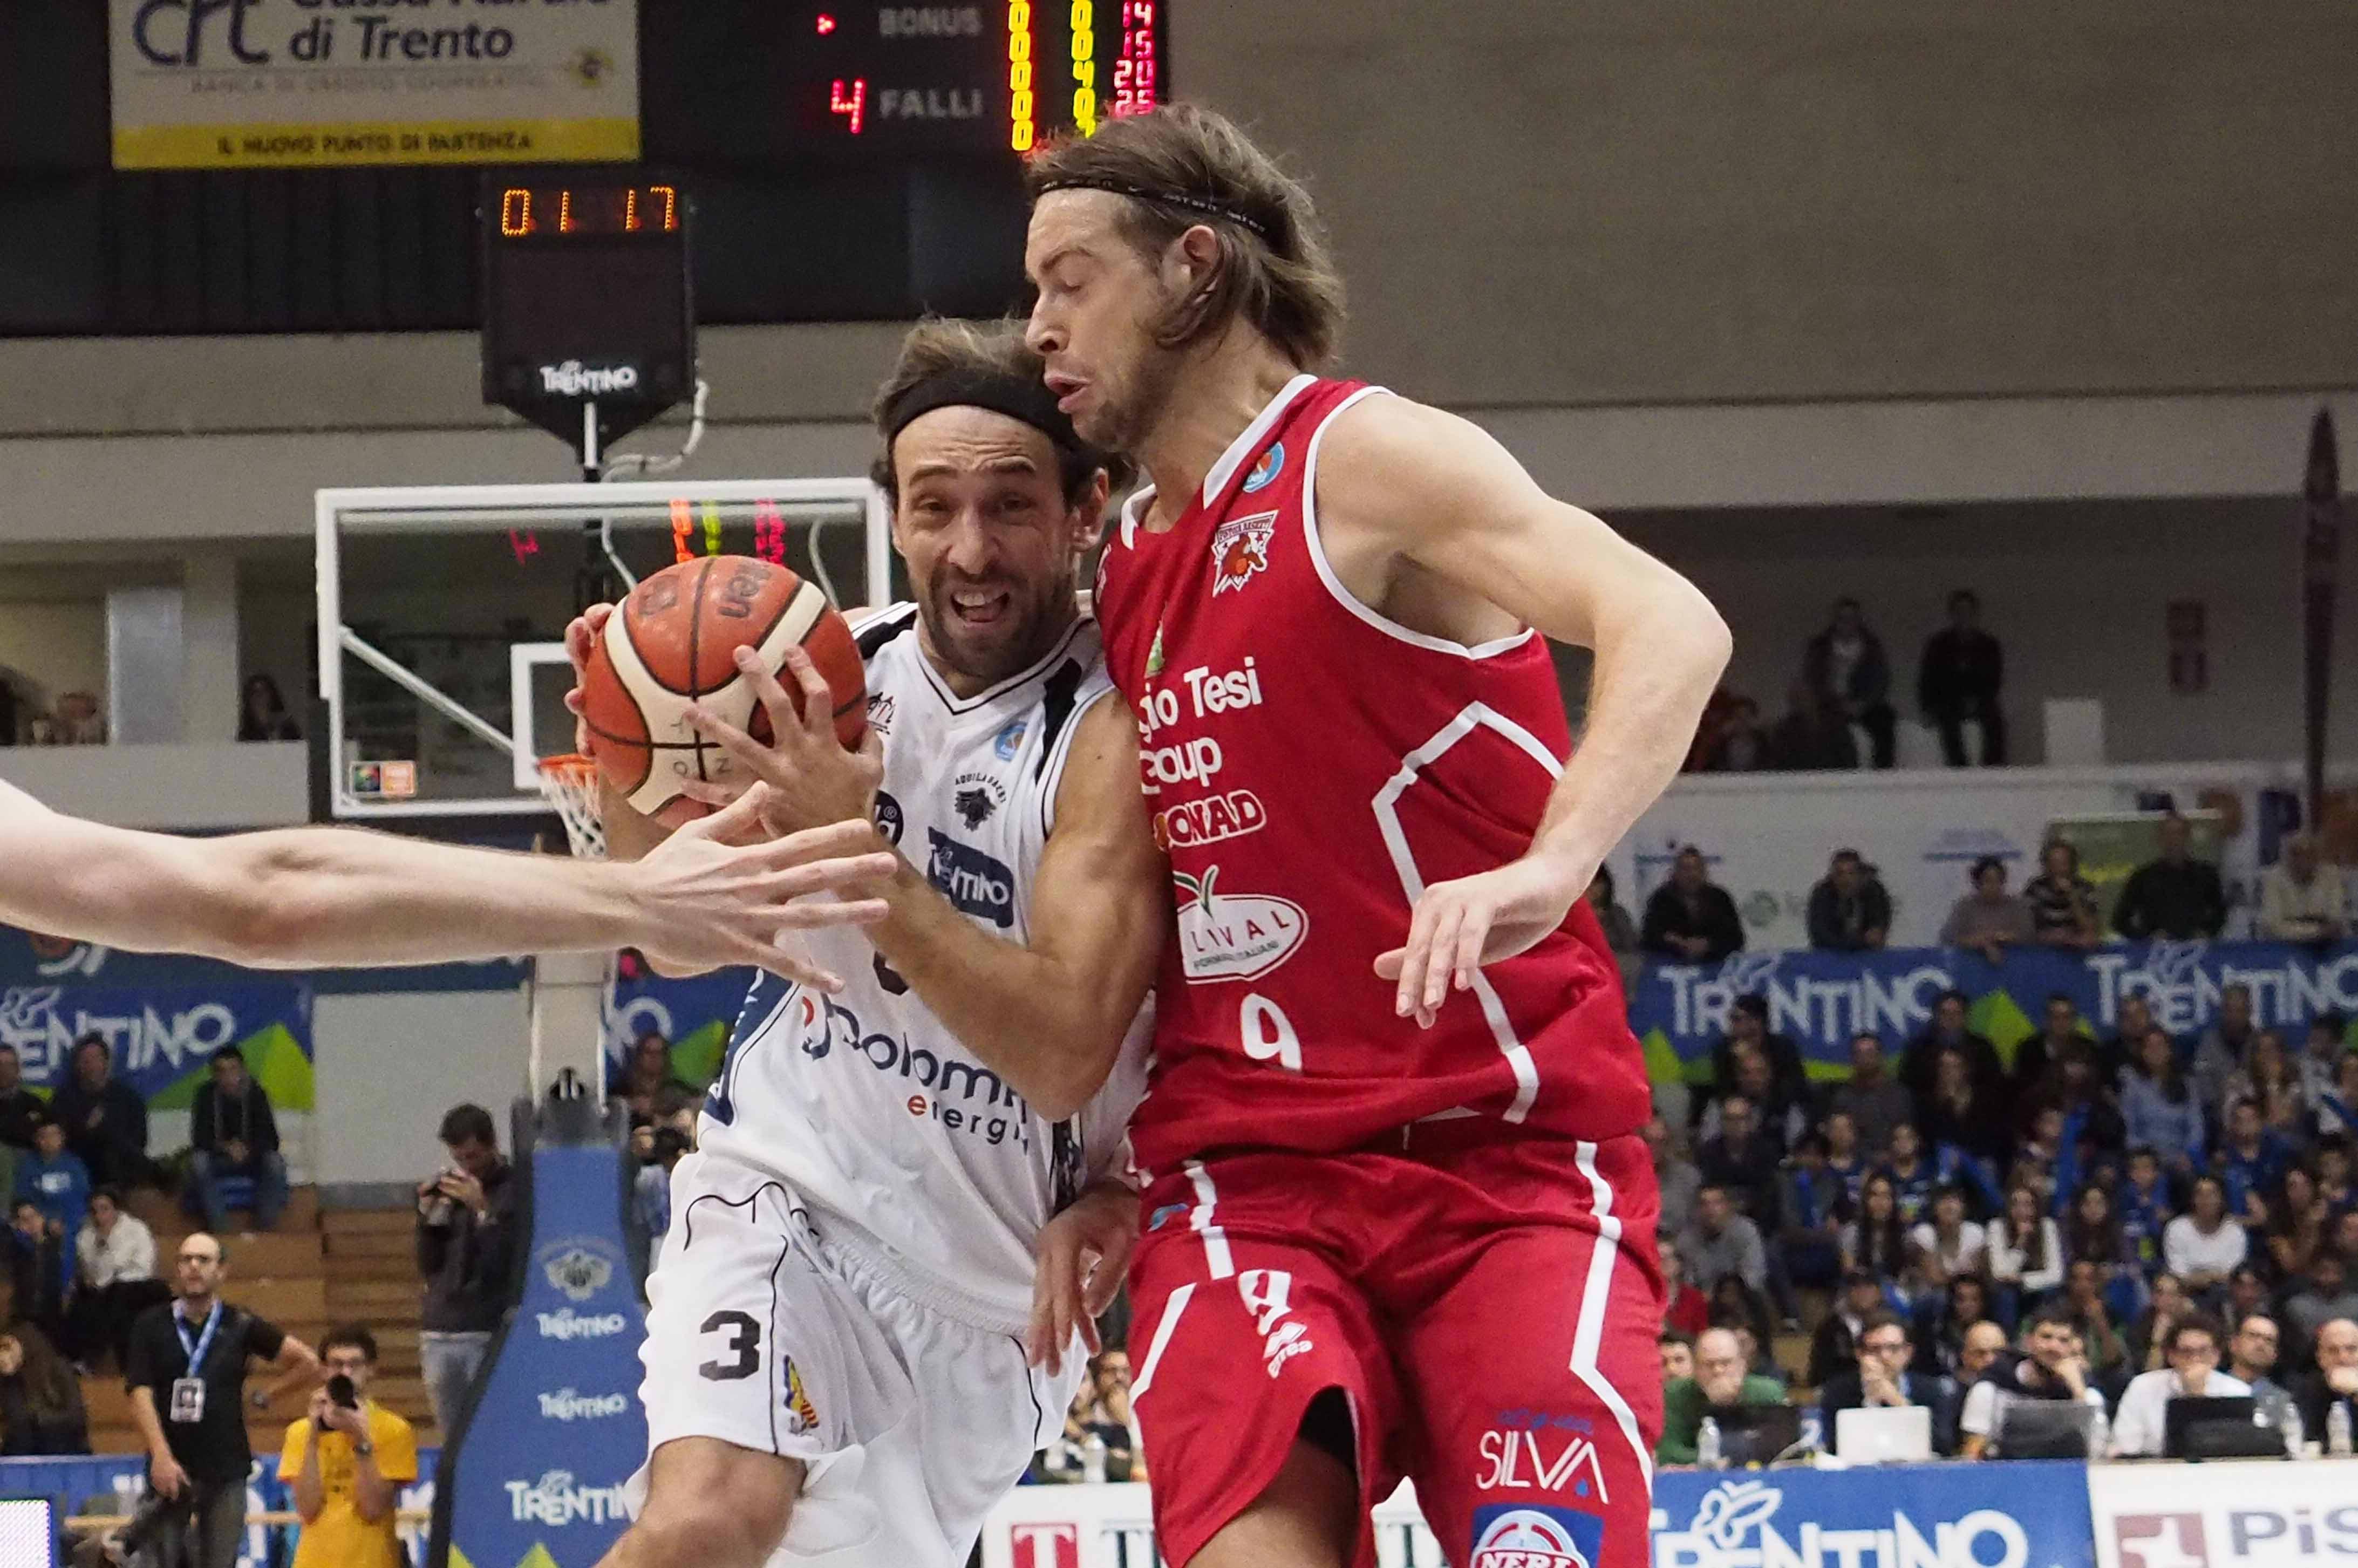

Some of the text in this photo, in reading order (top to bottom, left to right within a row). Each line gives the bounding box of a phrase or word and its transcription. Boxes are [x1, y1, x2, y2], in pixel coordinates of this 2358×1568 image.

[879, 8, 983, 36] BONUS
[1123, 2, 1152, 28] 14
[289, 15, 513, 61] di Trento
[1123, 30, 1153, 58] 15
[1114, 59, 1156, 89] 20
[831, 79, 865, 133] 4
[880, 89, 983, 119] FALLI
[323, 134, 393, 153] PUNTO
[502, 187, 674, 237] 01 17
[540, 365, 638, 397] TRENTINO
[1183, 656, 1263, 718] Tesi
[1658, 965, 1954, 1045] TRNTINO
[536, 1312, 626, 1340] TRENTINO
[699, 1310, 761, 1381] 3
[537, 1393, 629, 1421] TRENTINO
[1476, 1430, 1610, 1505] SILVA
[504, 1480, 625, 1526] TRENTI
